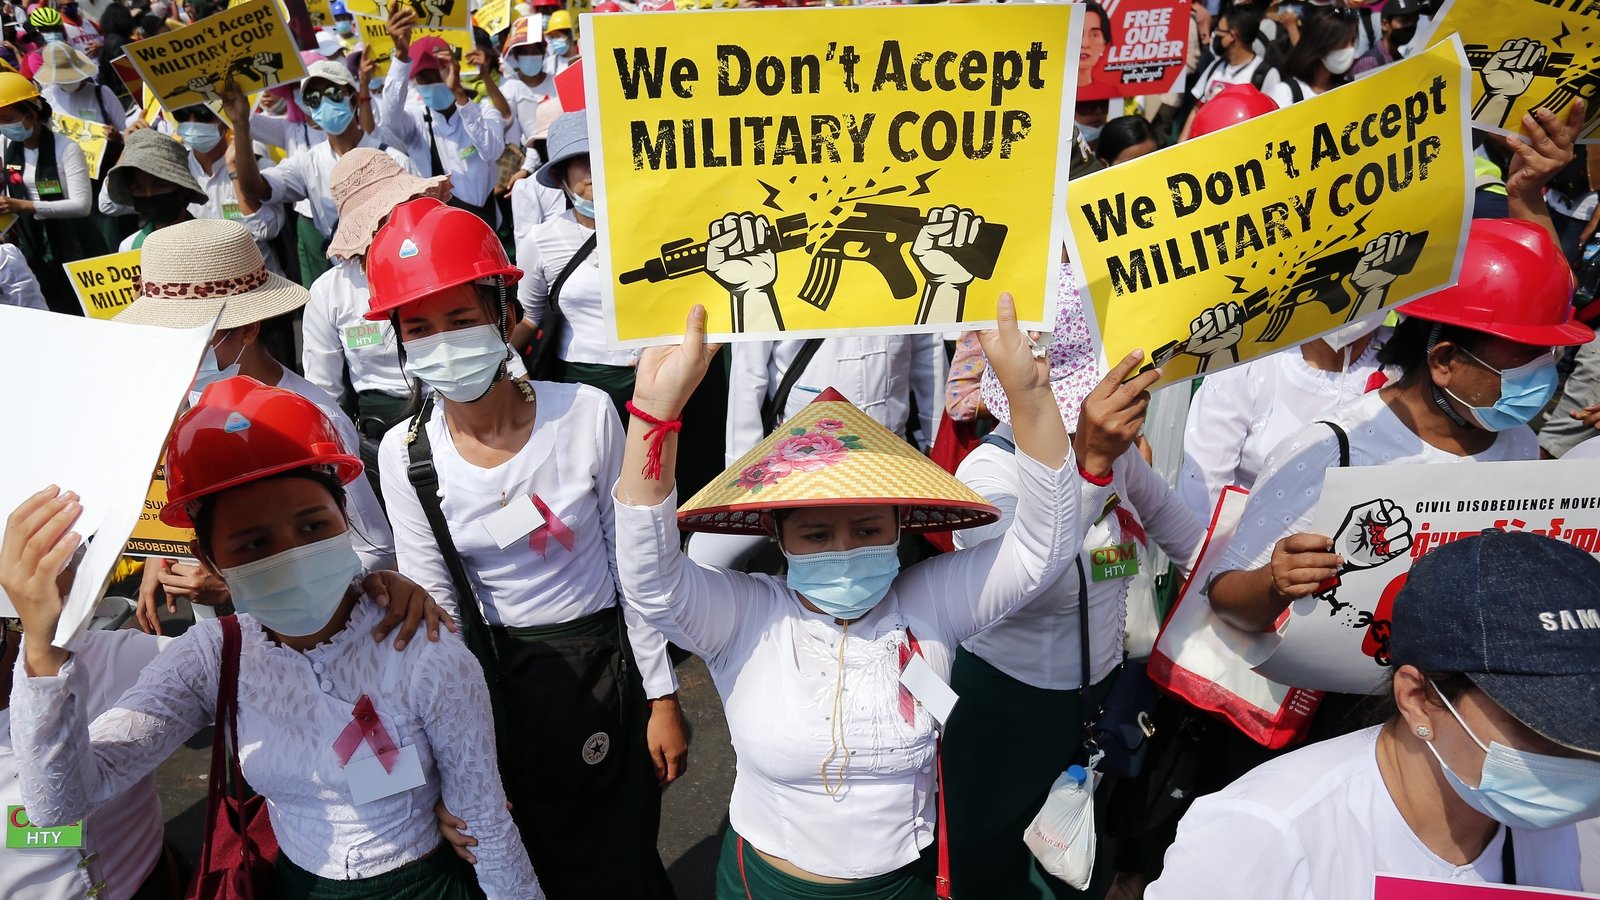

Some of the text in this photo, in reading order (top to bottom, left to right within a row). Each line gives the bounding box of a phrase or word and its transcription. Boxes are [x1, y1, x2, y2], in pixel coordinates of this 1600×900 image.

[1123, 7, 1173, 28] FREE
[136, 5, 273, 62] We Don't Accept
[1124, 26, 1169, 45] OUR
[150, 22, 275, 76] MILITARY COUP
[1107, 40, 1184, 63] LEADER
[612, 39, 1048, 106] We Don't Accept
[630, 109, 1032, 172] MILITARY COUP
[1081, 75, 1448, 243] We Don't Accept
[1106, 135, 1442, 297] MILITARY COUP
[77, 270, 105, 288] We
[347, 323, 378, 337] CDM
[356, 336, 373, 346] HTY
[1416, 501, 1451, 513] CIVIL
[1457, 499, 1555, 513] DISOBEDIENCE
[1092, 545, 1135, 566] CDM
[1104, 565, 1126, 577] HTY
[27, 831, 62, 845] HTY
